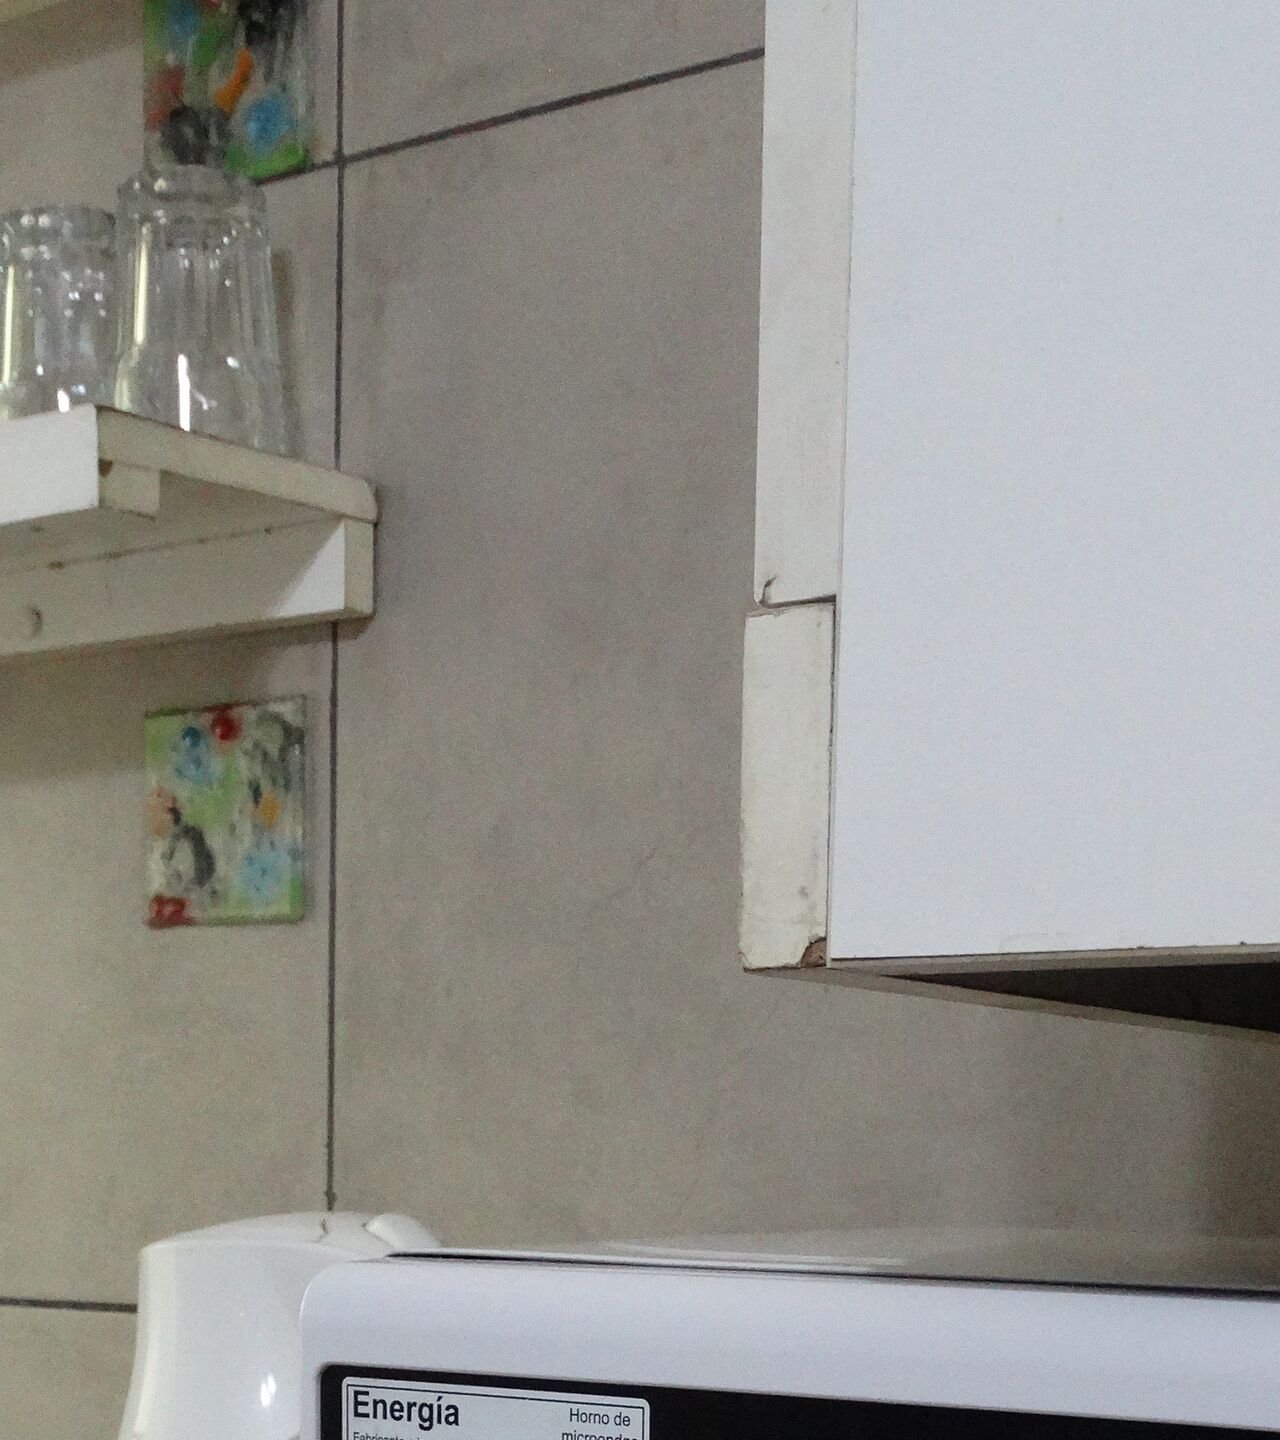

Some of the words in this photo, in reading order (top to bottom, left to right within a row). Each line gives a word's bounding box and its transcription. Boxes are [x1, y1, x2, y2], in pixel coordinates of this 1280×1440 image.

[353, 1390, 460, 1431] Energía
[569, 1408, 610, 1425] Horno
[614, 1412, 631, 1427] de
